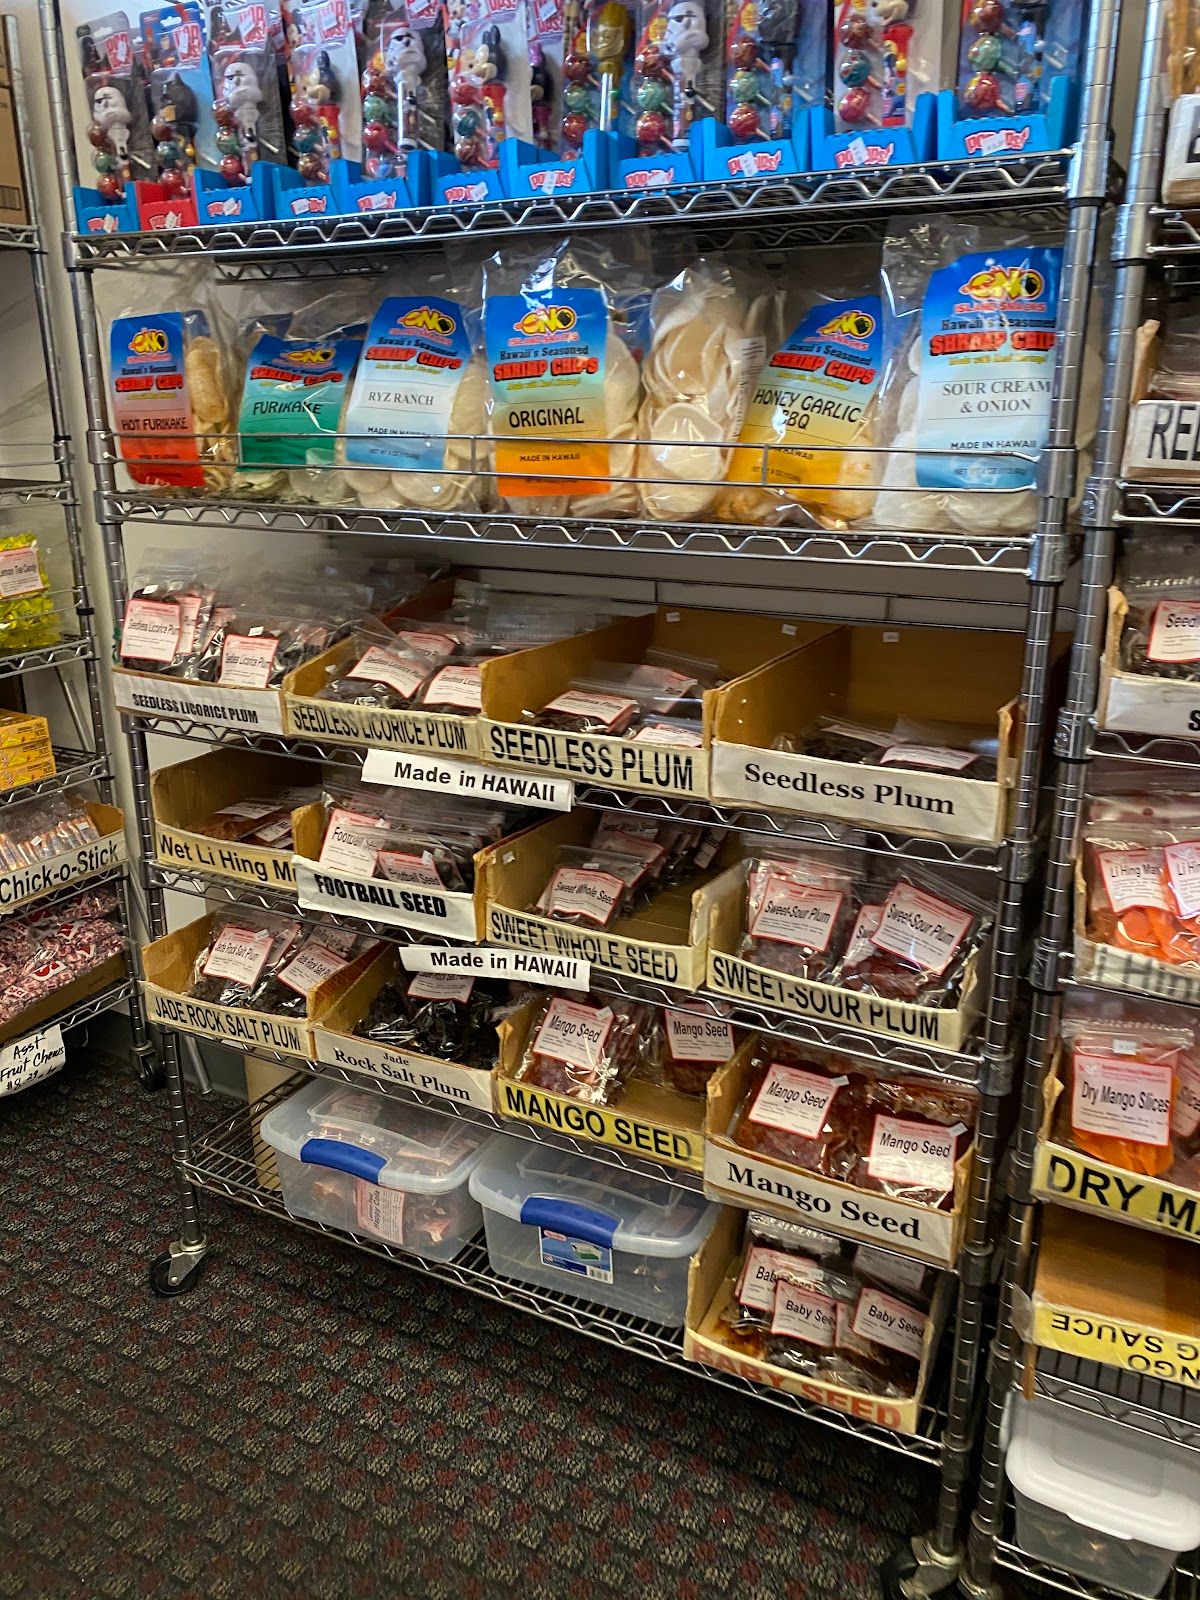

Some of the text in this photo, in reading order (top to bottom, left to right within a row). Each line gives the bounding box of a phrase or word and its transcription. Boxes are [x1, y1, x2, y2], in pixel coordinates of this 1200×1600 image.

[365, 347, 418, 361] SHRIMP
[417, 351, 463, 369] CHIPS
[542, 345, 589, 357] Seasoned
[930, 331, 1007, 356] SHRIMP
[493, 357, 600, 381] SHRIMP CHIPS
[769, 352, 825, 372] SHRIMP
[825, 360, 876, 385] CHIPS
[368, 391, 435, 406] RYZ RANCH
[943, 380, 1052, 396] SOUR CREAM
[253, 400, 323, 416] FURIKAKE
[508, 407, 585, 429] ORIGINAL
[753, 388, 863, 423] HONEY GARLIC
[960, 399, 1032, 413] & ONION
[121, 417, 188, 431] HOT FURIKAKE
[520, 452, 580, 463] MADE IN HAWAII
[951, 440, 1037, 450] MADE IN HAWAII
[132, 693, 259, 724] SEEDLESS LICORICE PLUM
[293, 705, 468, 750] SEEDLESS LICORICE PLUM
[490, 726, 694, 792] SEEDLESS PLUM
[394, 761, 556, 803] Made in HAWAII
[744, 763, 955, 816] Seedless Plum
[0, 840, 119, 904] Chick-o-Stick
[159, 835, 193, 862] Wet
[196, 844, 215, 867] Li
[219, 849, 268, 882] Hing
[313, 873, 447, 919] FOOTBALL SEED
[554, 881, 575, 894] Sweet
[575, 883, 597, 898] Whole
[764, 900, 831, 924] Sweet-Sour Plum
[887, 903, 931, 935] Sweet-Sour
[930, 924, 956, 945] Plum
[490, 911, 679, 984] SWEET WHOLE SEED
[430, 951, 578, 980] Made in HAWAII
[713, 956, 940, 1042] SWEET-SOUR PLUM
[155, 996, 301, 1051] JADE ROCK SALT PLUM
[550, 1014, 602, 1044] Mango Seed
[673, 1020, 729, 1038] Mango Seed
[0, 1057, 31, 1082] Fruit
[383, 1051, 410, 1067] Jade
[334, 1048, 473, 1103] Rock Salt Plum
[767, 1081, 830, 1109] Mango Seed
[1081, 1080, 1170, 1115] Dry Mango Slices
[505, 1086, 693, 1161] MANGO SEED
[879, 1132, 952, 1158] Mango Seed
[1048, 1155, 1144, 1212] DRY
[373, 1189, 382, 1230] Happy Cola
[727, 1161, 922, 1241] Mango Seed
[785, 1300, 813, 1320] Baby
[868, 1304, 925, 1338] Baby Seed
[1051, 1312, 1164, 1354] SAUCE
[691, 1341, 902, 1431] BABY SEED
